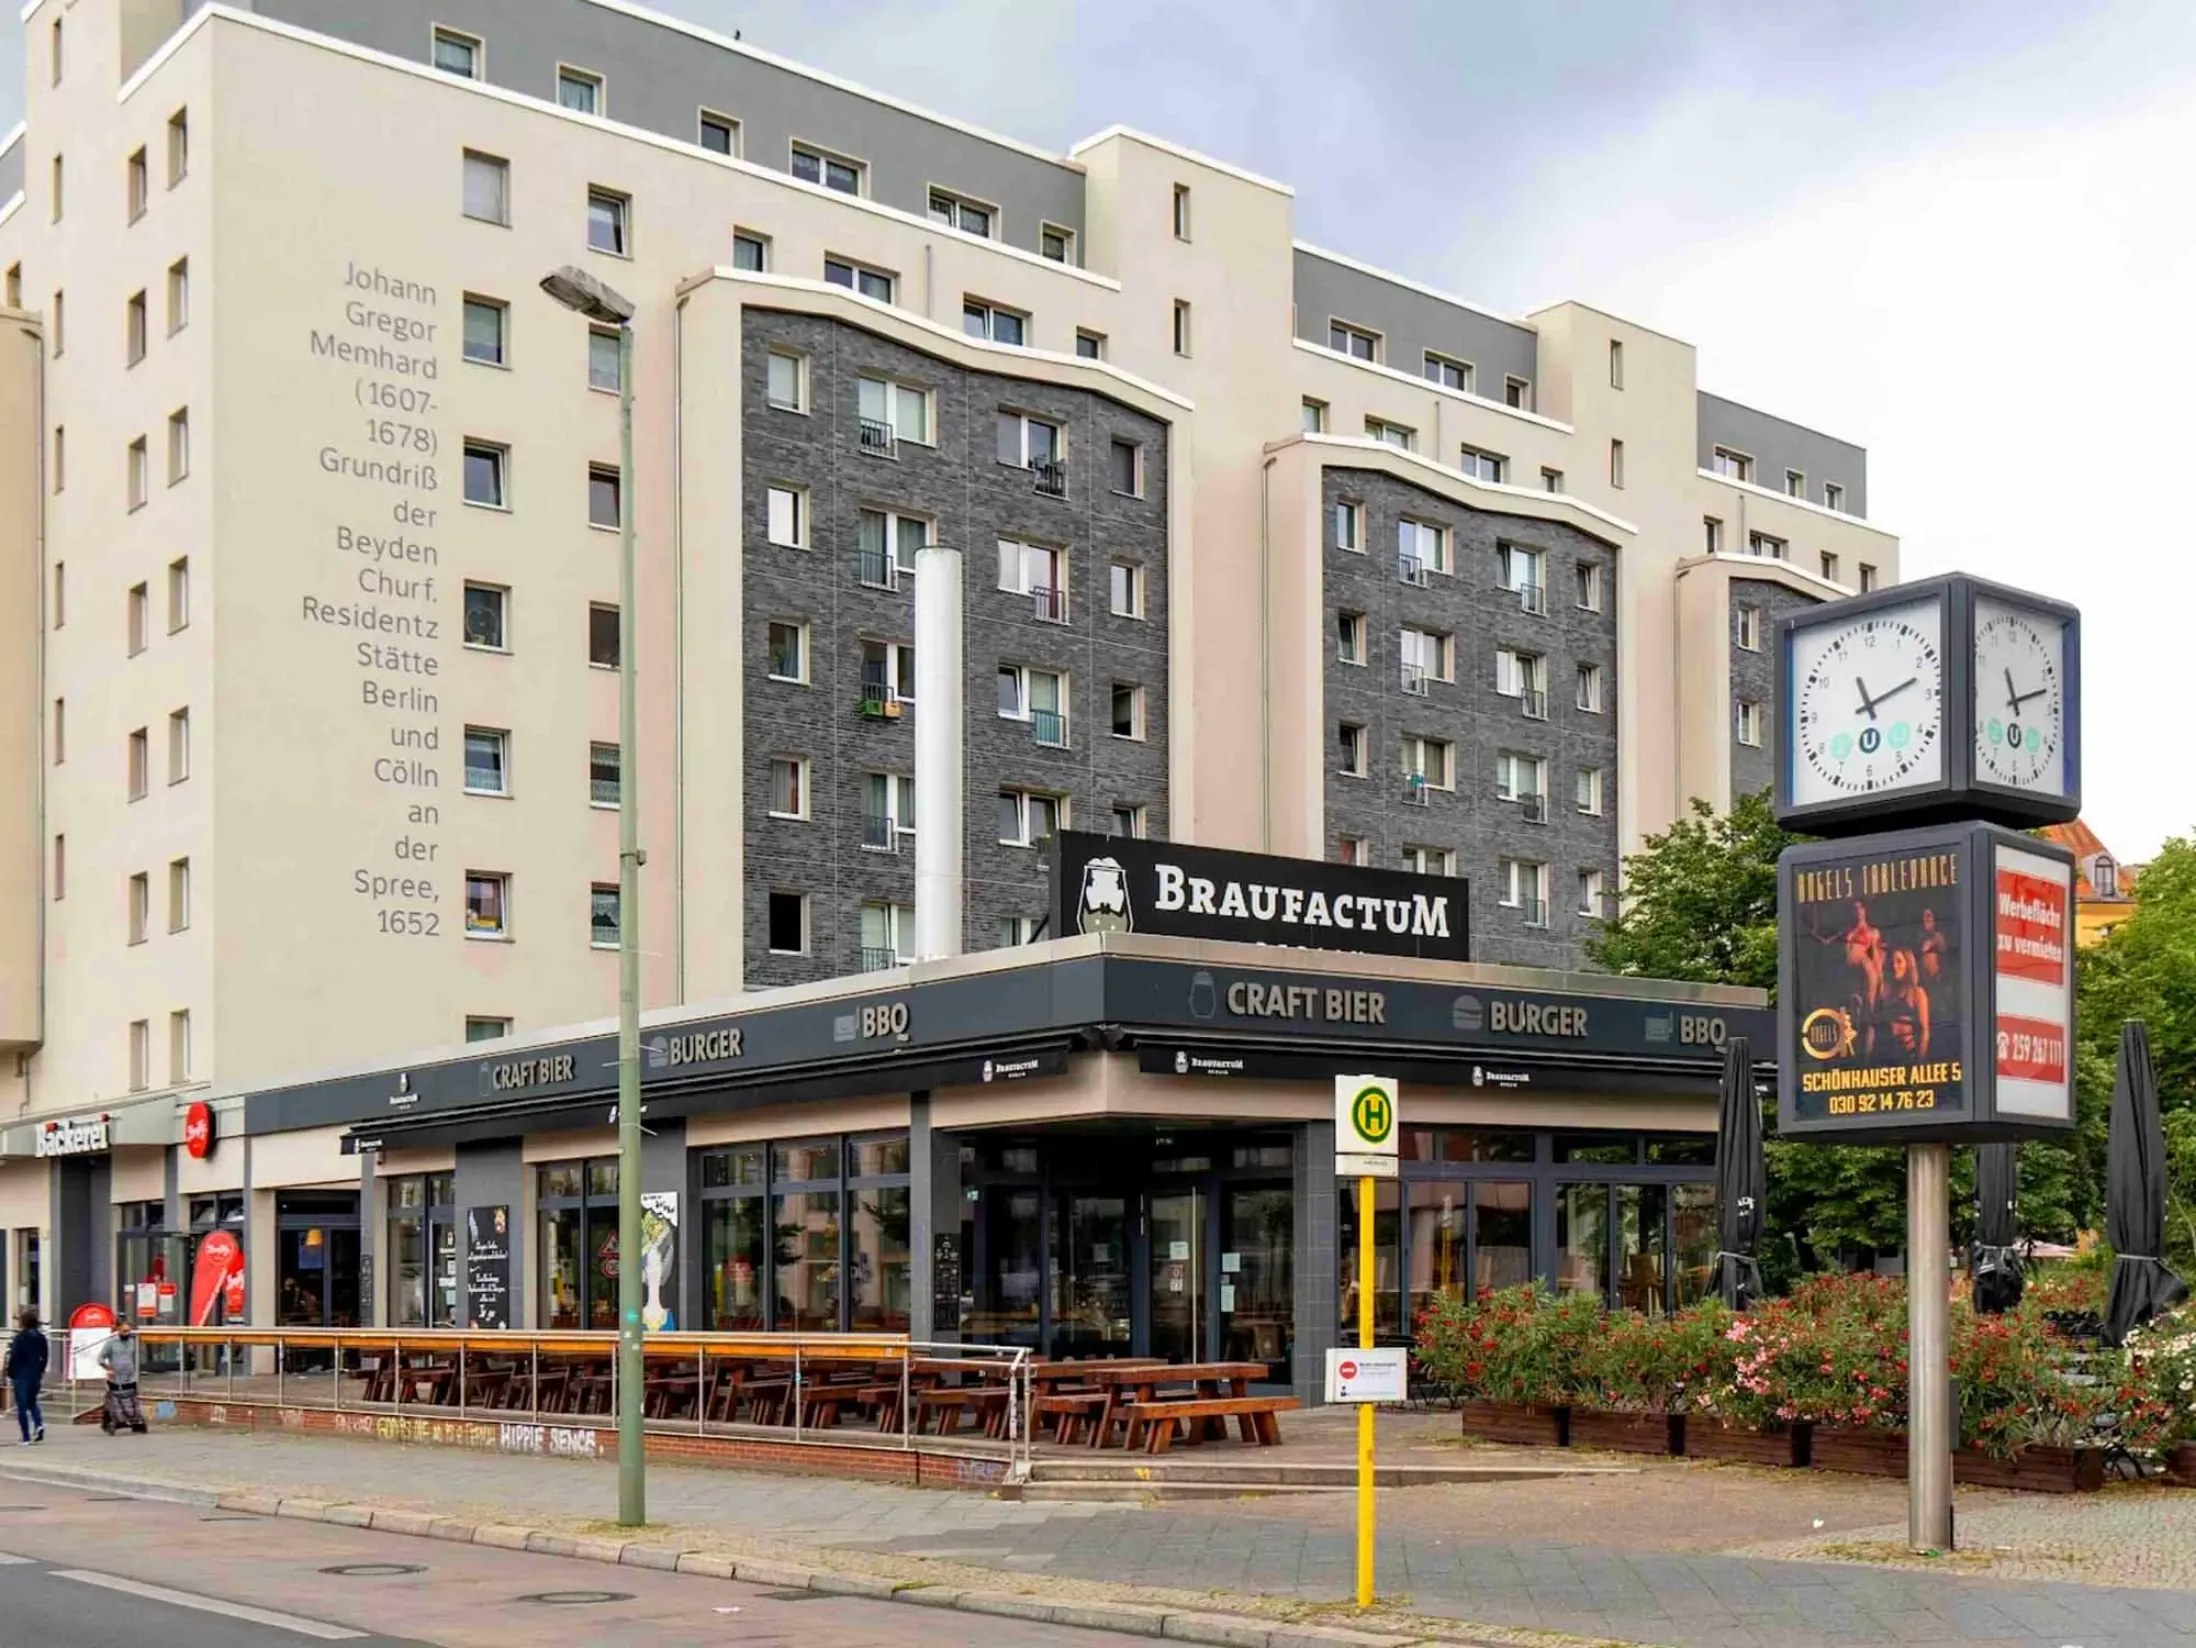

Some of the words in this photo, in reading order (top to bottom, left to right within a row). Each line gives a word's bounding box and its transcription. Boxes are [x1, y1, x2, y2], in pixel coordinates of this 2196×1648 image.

[344, 261, 437, 307] Johann
[345, 301, 438, 343] Gregor
[310, 329, 438, 380] Memhard
[354, 377, 438, 414] (1607-
[365, 418, 438, 457] 1678)
[319, 446, 438, 491] Grundriß
[393, 500, 437, 528] der
[336, 526, 438, 566] Beyden
[358, 568, 438, 602] Churf.
[302, 596, 439, 640] Residentz
[357, 643, 439, 676] Stätte
[362, 681, 438, 713] Berlin
[391, 726, 438, 750] und
[374, 758, 438, 788] Cölln
[408, 804, 438, 825] an
[394, 835, 438, 862] der
[354, 869, 439, 904] Spree,
[378, 910, 440, 936] 1652
[1998, 892, 2061, 929] Werbefläche
[1997, 933, 2012, 952] zu
[2014, 935, 2062, 963] vermieten
[1226, 980, 1318, 1019] CRAFT
[1325, 988, 1386, 1025] BIER
[1490, 1000, 1589, 1038] BURGER
[862, 1002, 910, 1043] BBQ
[1680, 1015, 1727, 1054] BBQ
[670, 1028, 744, 1065] BURGER
[492, 1059, 539, 1091] CRAFT
[539, 1053, 576, 1085] BIER
[1803, 1066, 1906, 1092] SCHÖNHAUSER
[1910, 1063, 1949, 1084] ALLEE
[1951, 1062, 1962, 1081] 5
[1364, 1099, 1383, 1130] H
[1829, 1095, 1855, 1114] 030
[1858, 1093, 1876, 1112] 92
[1880, 1092, 1893, 1110] 14
[1896, 1091, 1913, 1109] 76
[1917, 1089, 1934, 1108] 23
[35, 1113, 109, 1158] Bäckerei
